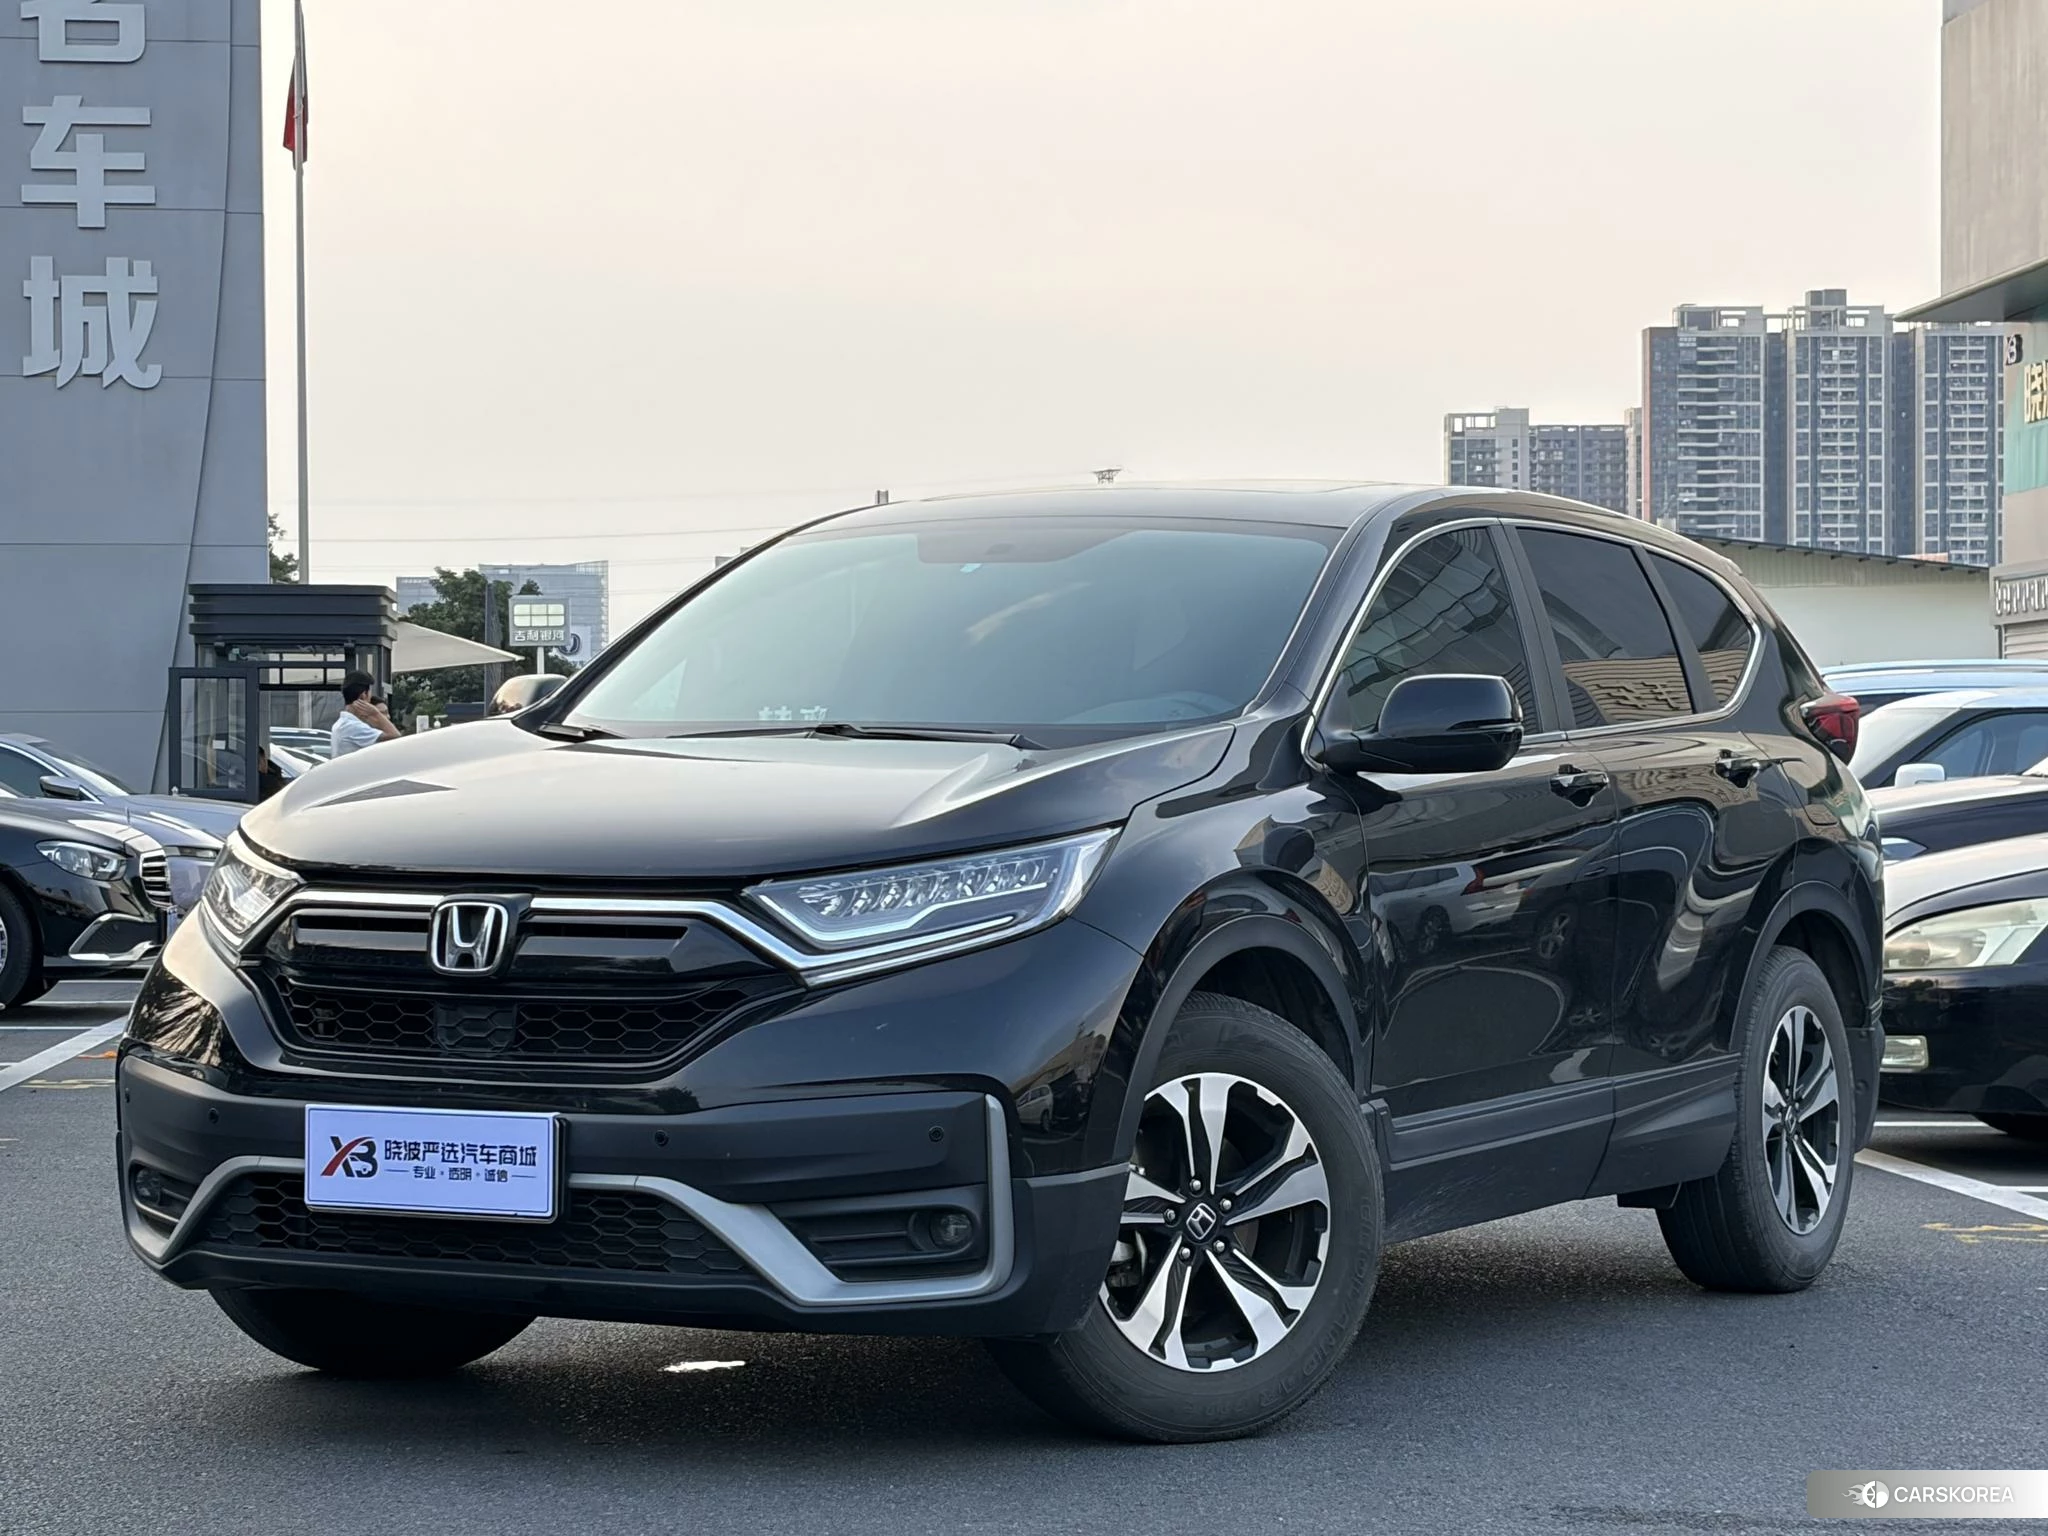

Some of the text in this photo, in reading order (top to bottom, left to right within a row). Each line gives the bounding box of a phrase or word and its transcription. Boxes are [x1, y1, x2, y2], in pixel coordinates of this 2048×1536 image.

[384, 1139, 537, 1168] 晓波严选汽车商城
